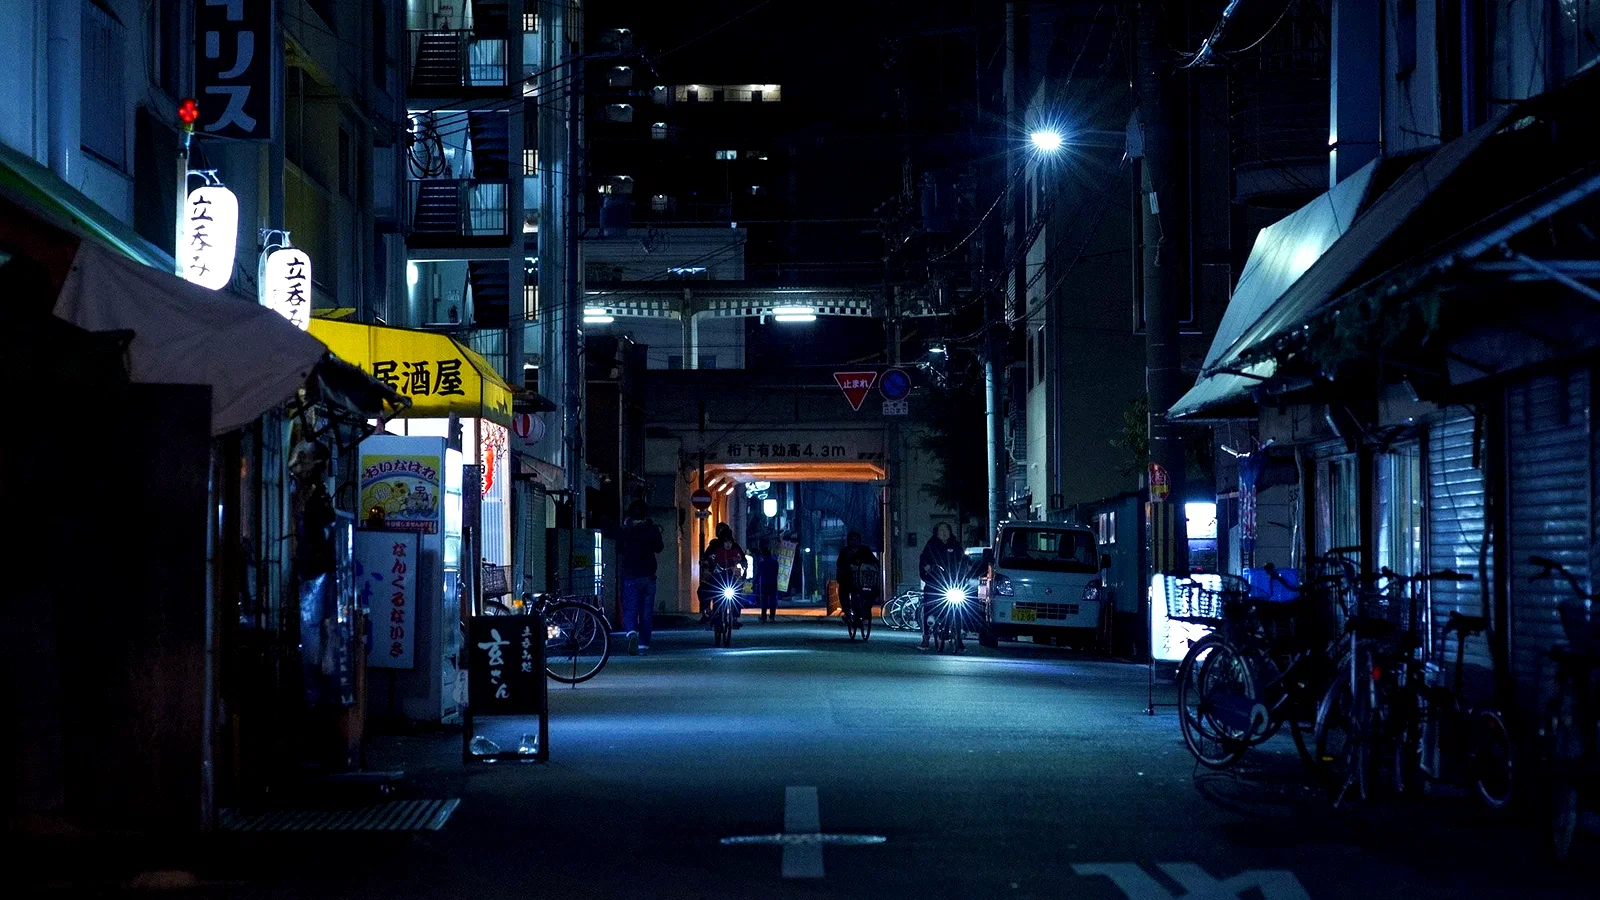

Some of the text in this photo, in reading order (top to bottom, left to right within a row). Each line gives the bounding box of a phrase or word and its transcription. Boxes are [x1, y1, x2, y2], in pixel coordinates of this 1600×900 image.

[204, 0, 257, 132] リス
[190, 195, 214, 277] 立呑み
[371, 358, 465, 396] 居酒屋
[842, 378, 869, 389] 止まれ
[727, 443, 846, 458] 桁下有効高4.3m
[364, 459, 436, 480] おいなはれ
